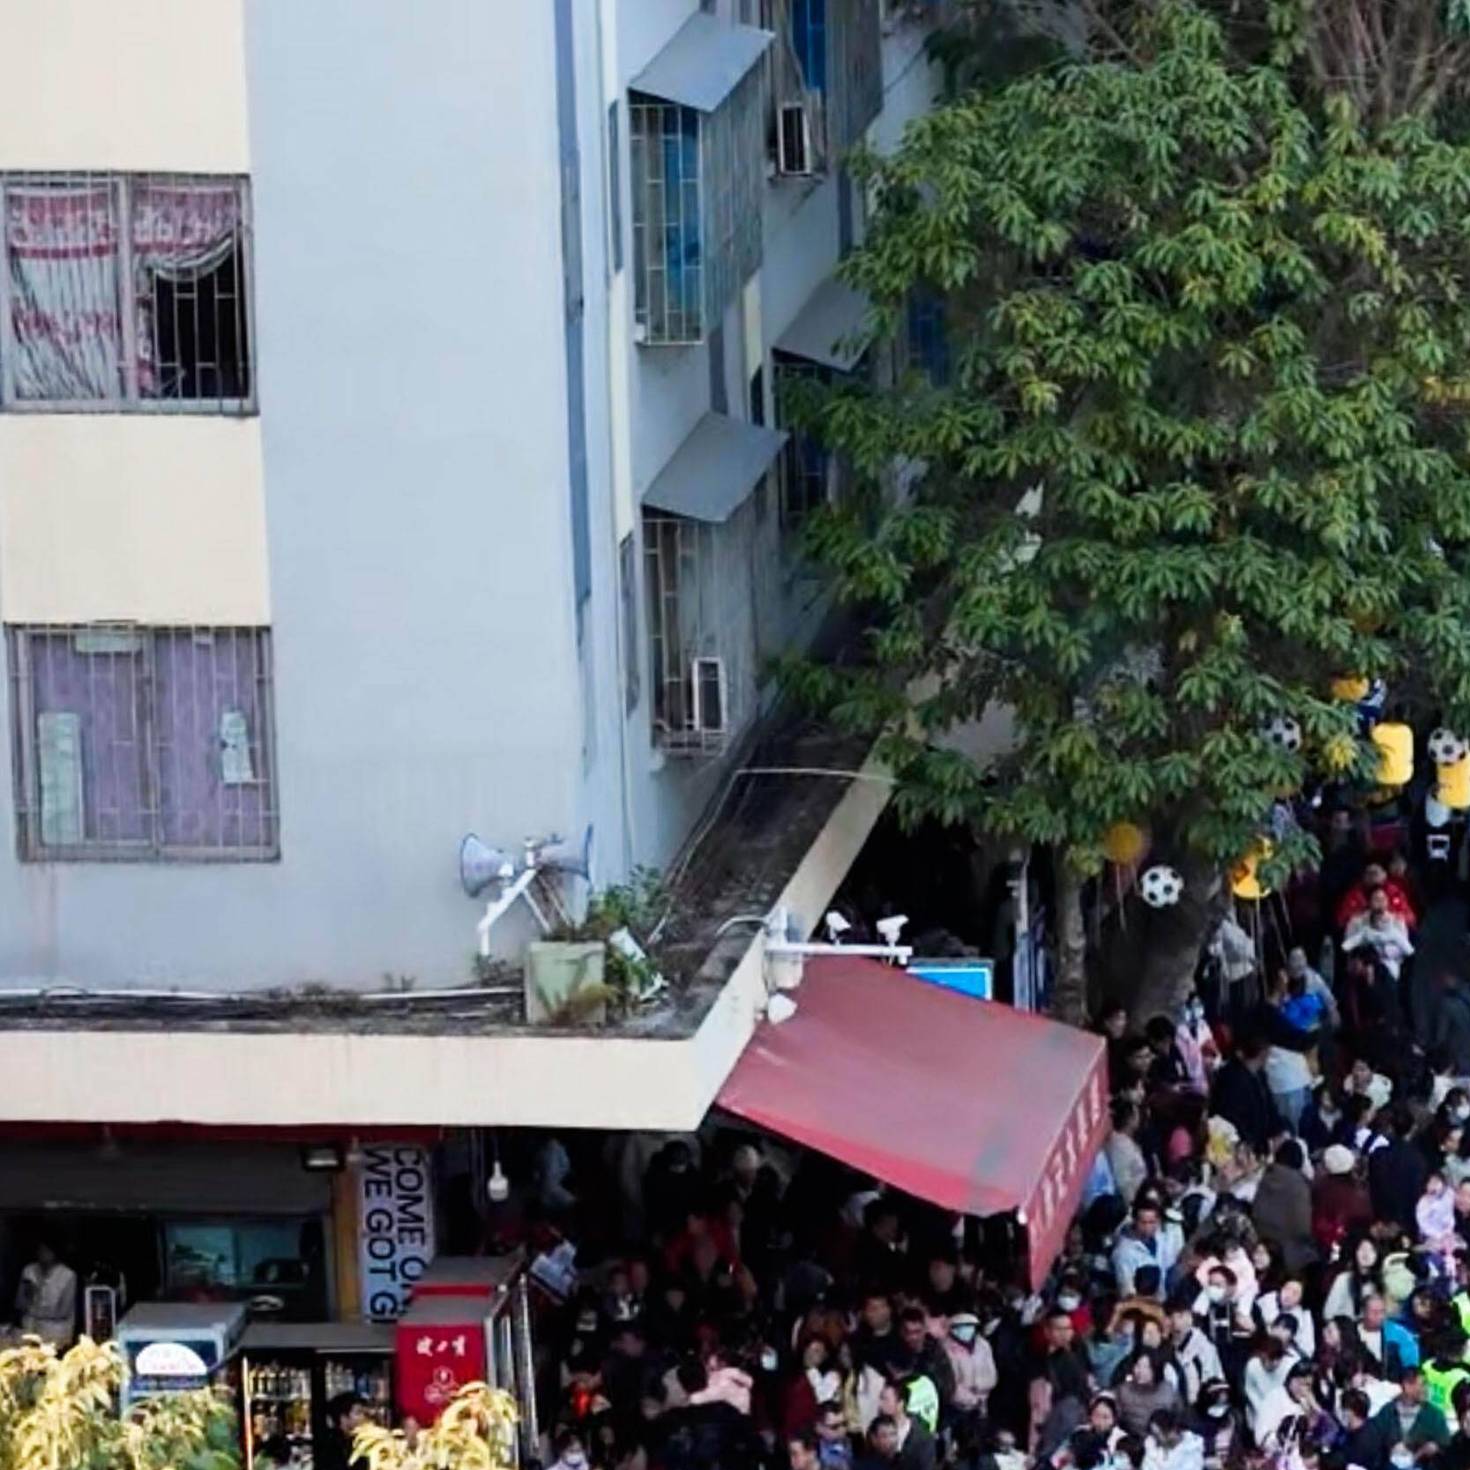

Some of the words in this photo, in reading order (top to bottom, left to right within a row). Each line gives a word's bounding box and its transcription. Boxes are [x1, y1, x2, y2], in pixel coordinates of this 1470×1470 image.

[363, 1150, 393, 1199] WE
[393, 1148, 427, 1246] COME
[365, 1208, 397, 1282] GOT
